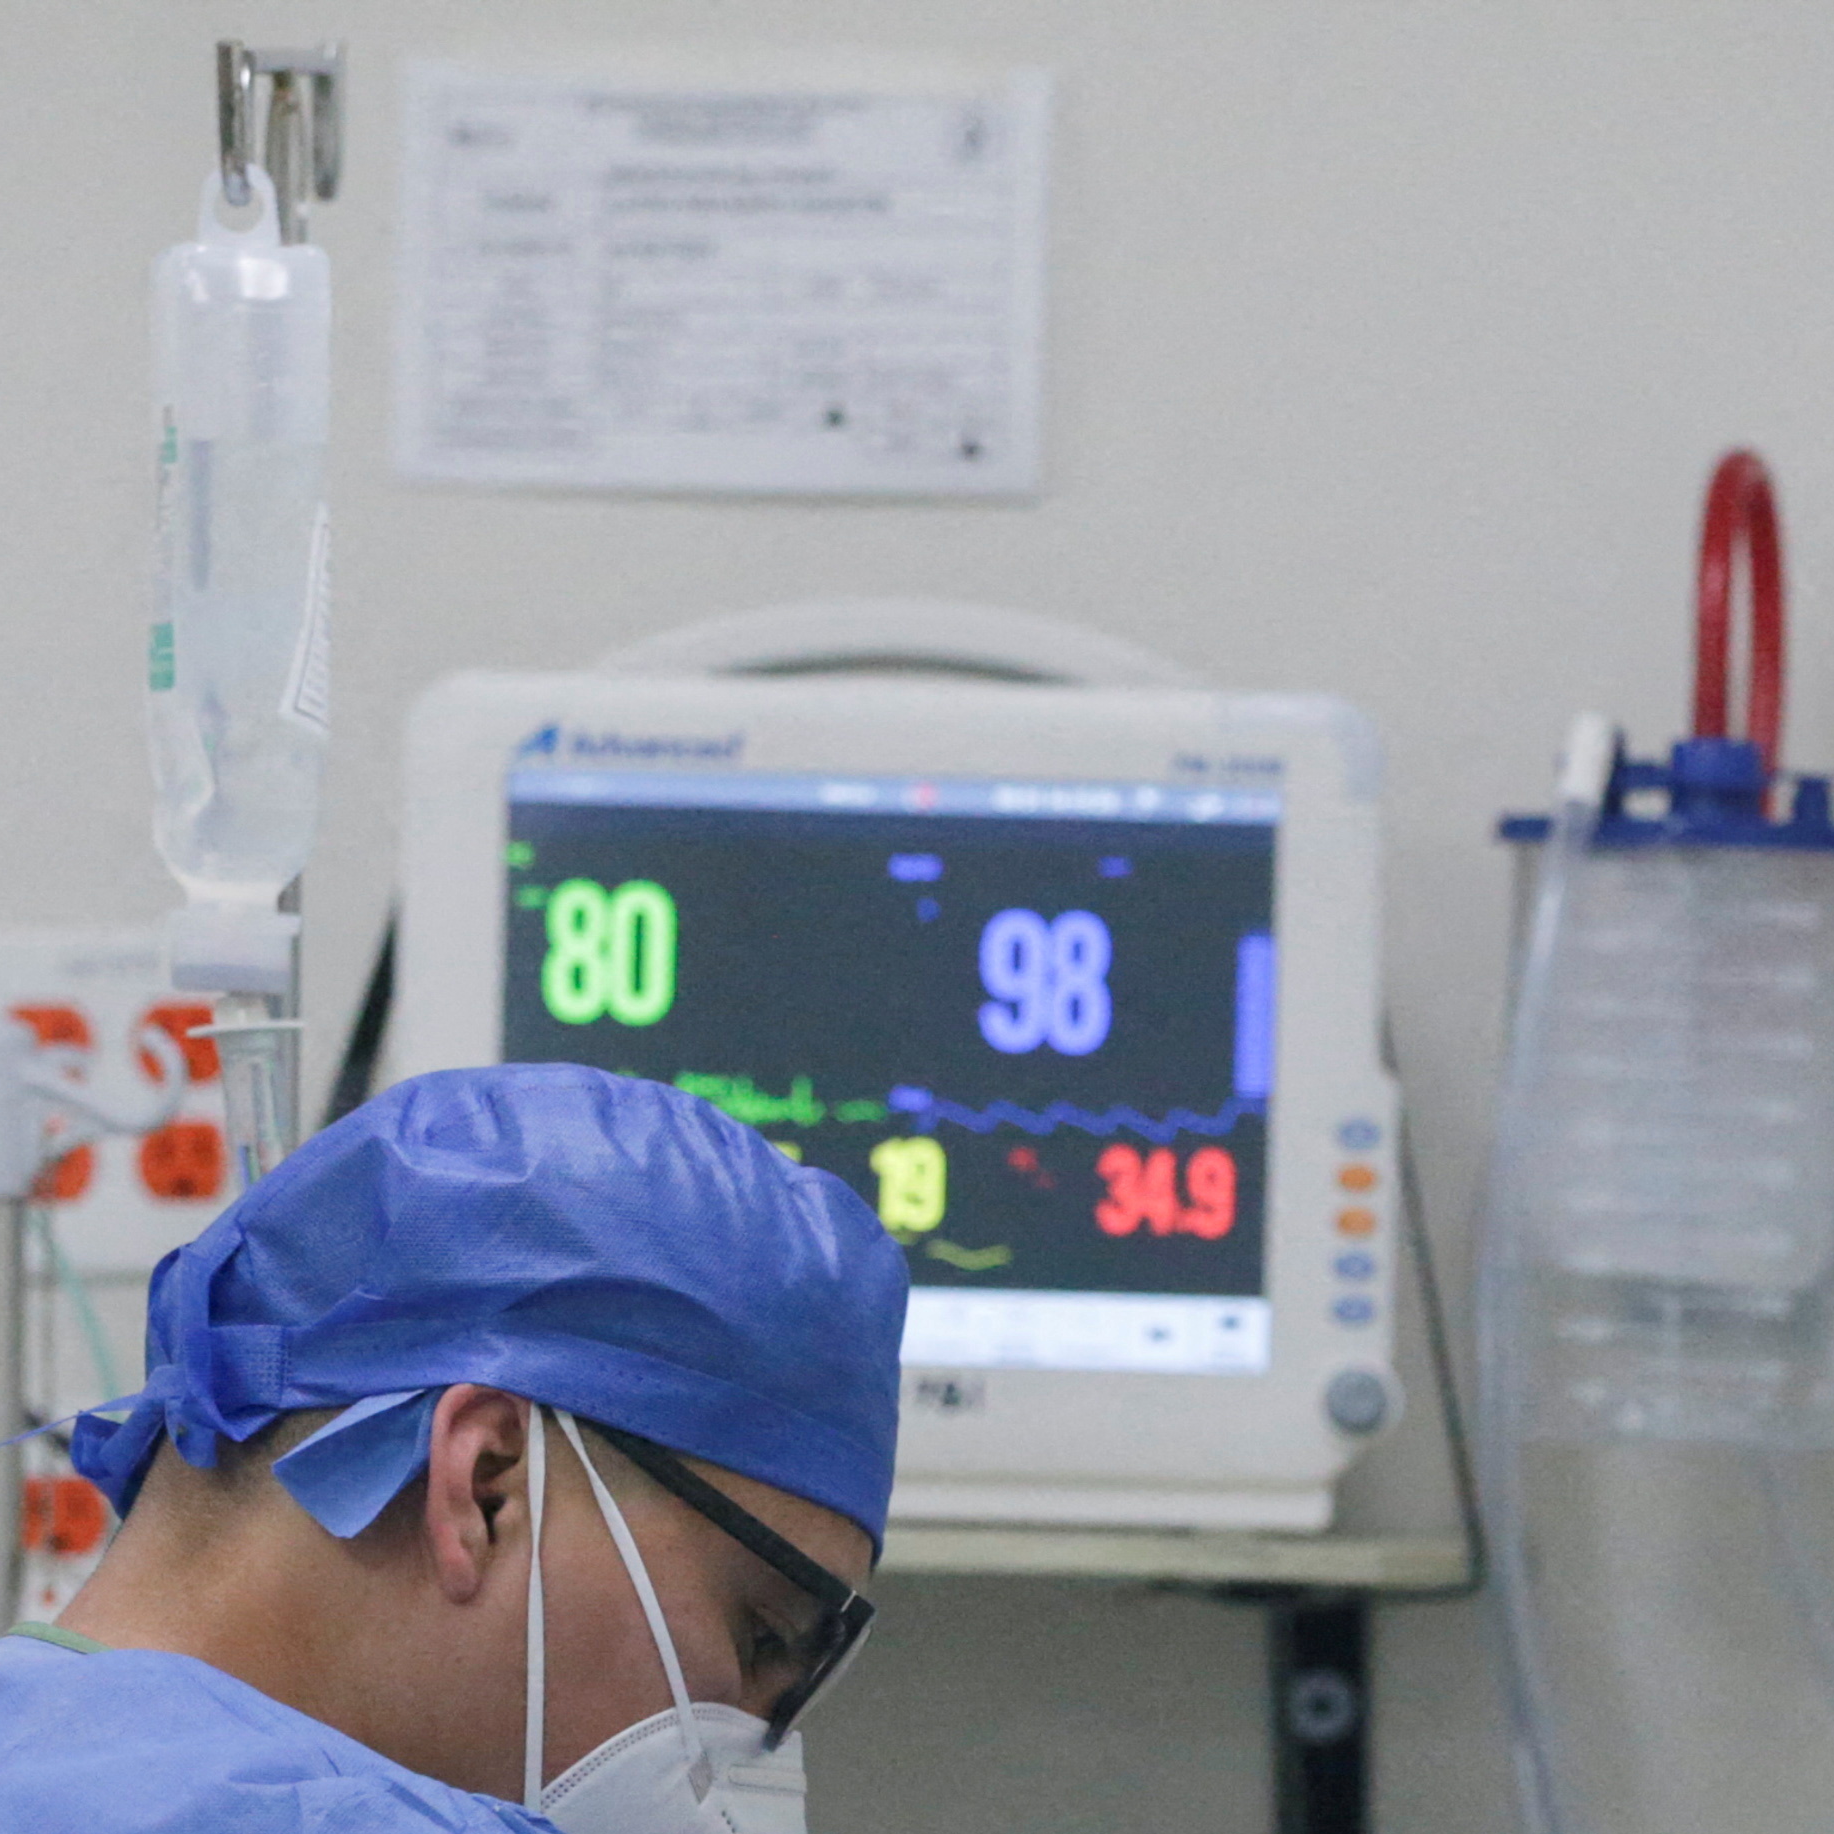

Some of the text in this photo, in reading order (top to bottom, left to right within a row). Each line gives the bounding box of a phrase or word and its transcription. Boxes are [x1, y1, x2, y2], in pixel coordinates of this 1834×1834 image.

[542, 878, 678, 1026] 80
[978, 908, 1113, 1056] 98
[871, 1136, 947, 1232] 19
[1095, 1143, 1236, 1240] 34.9
